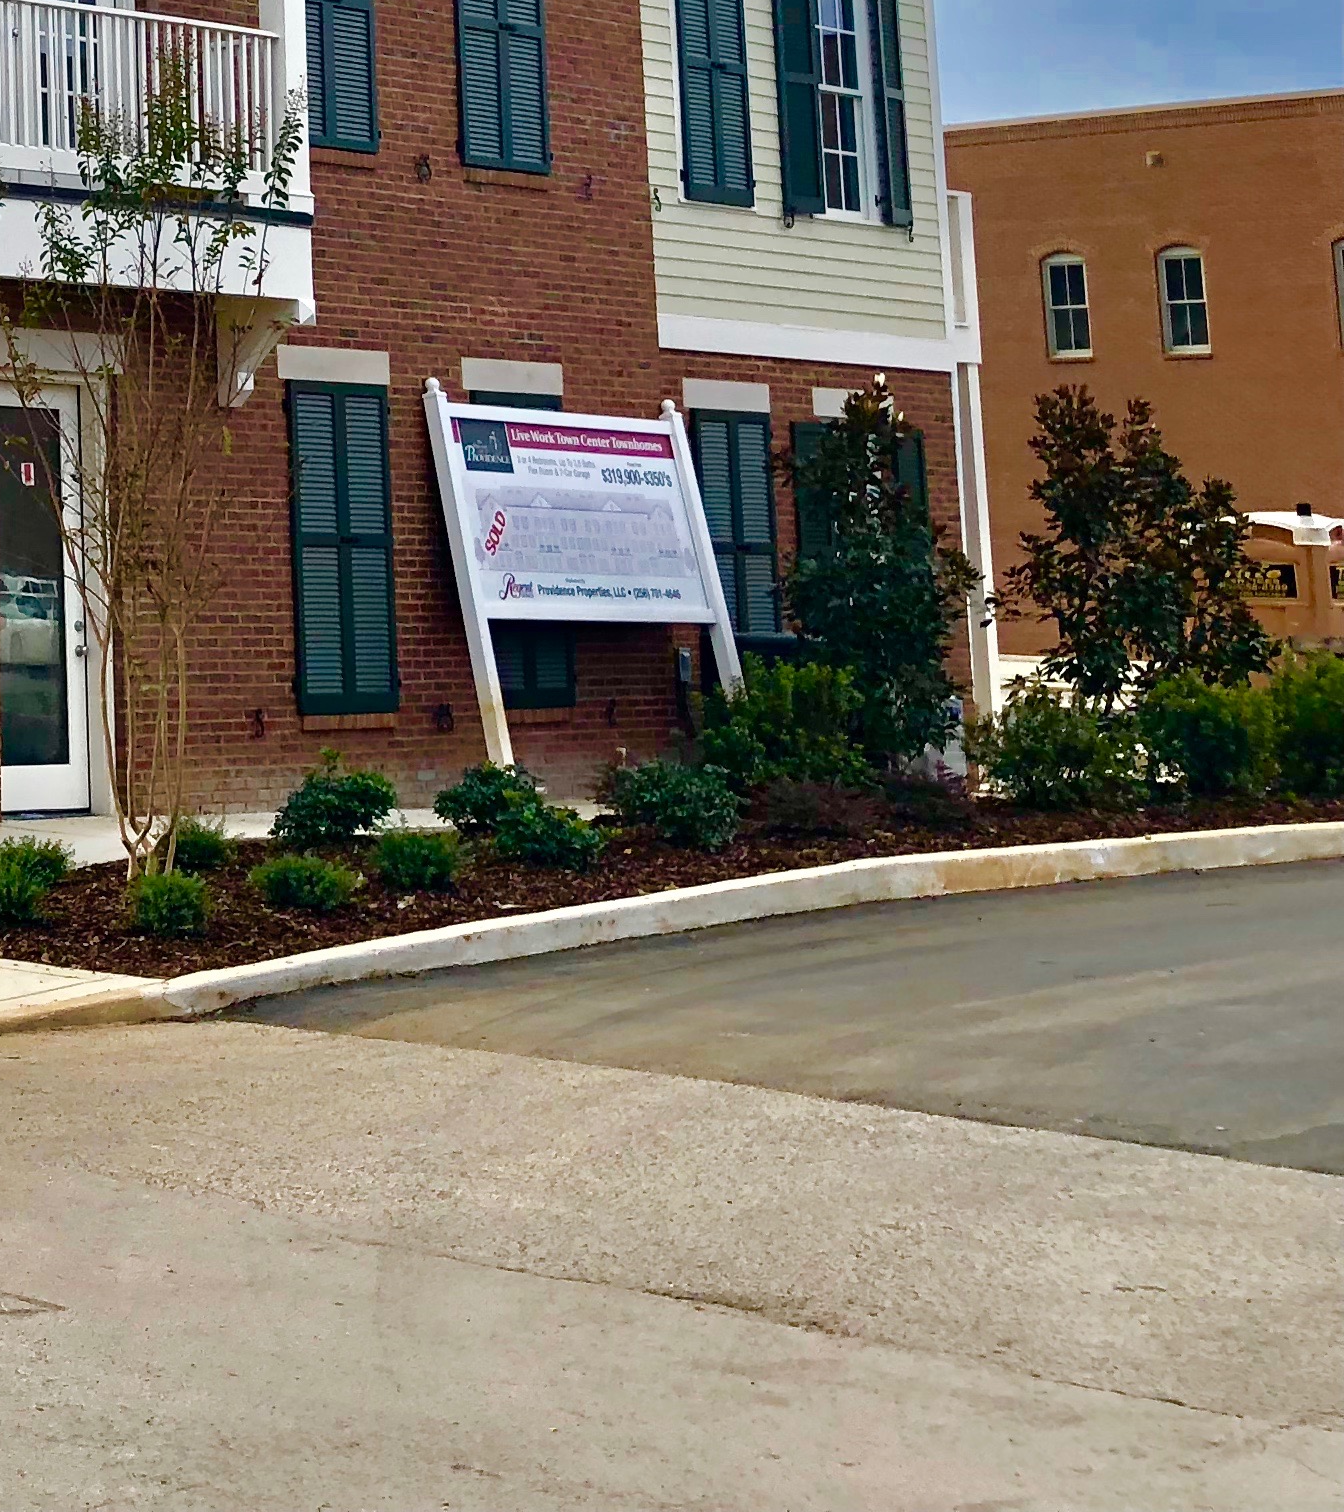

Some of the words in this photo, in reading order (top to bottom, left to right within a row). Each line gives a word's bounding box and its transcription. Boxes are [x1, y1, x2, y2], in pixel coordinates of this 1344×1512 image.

[510, 428, 531, 442] Live
[530, 430, 555, 444] Work
[554, 432, 580, 445] Town
[580, 434, 610, 448] Center
[610, 436, 662, 452] Townhomes
[485, 511, 506, 556] SOLD
[537, 584, 575, 596] Providence
